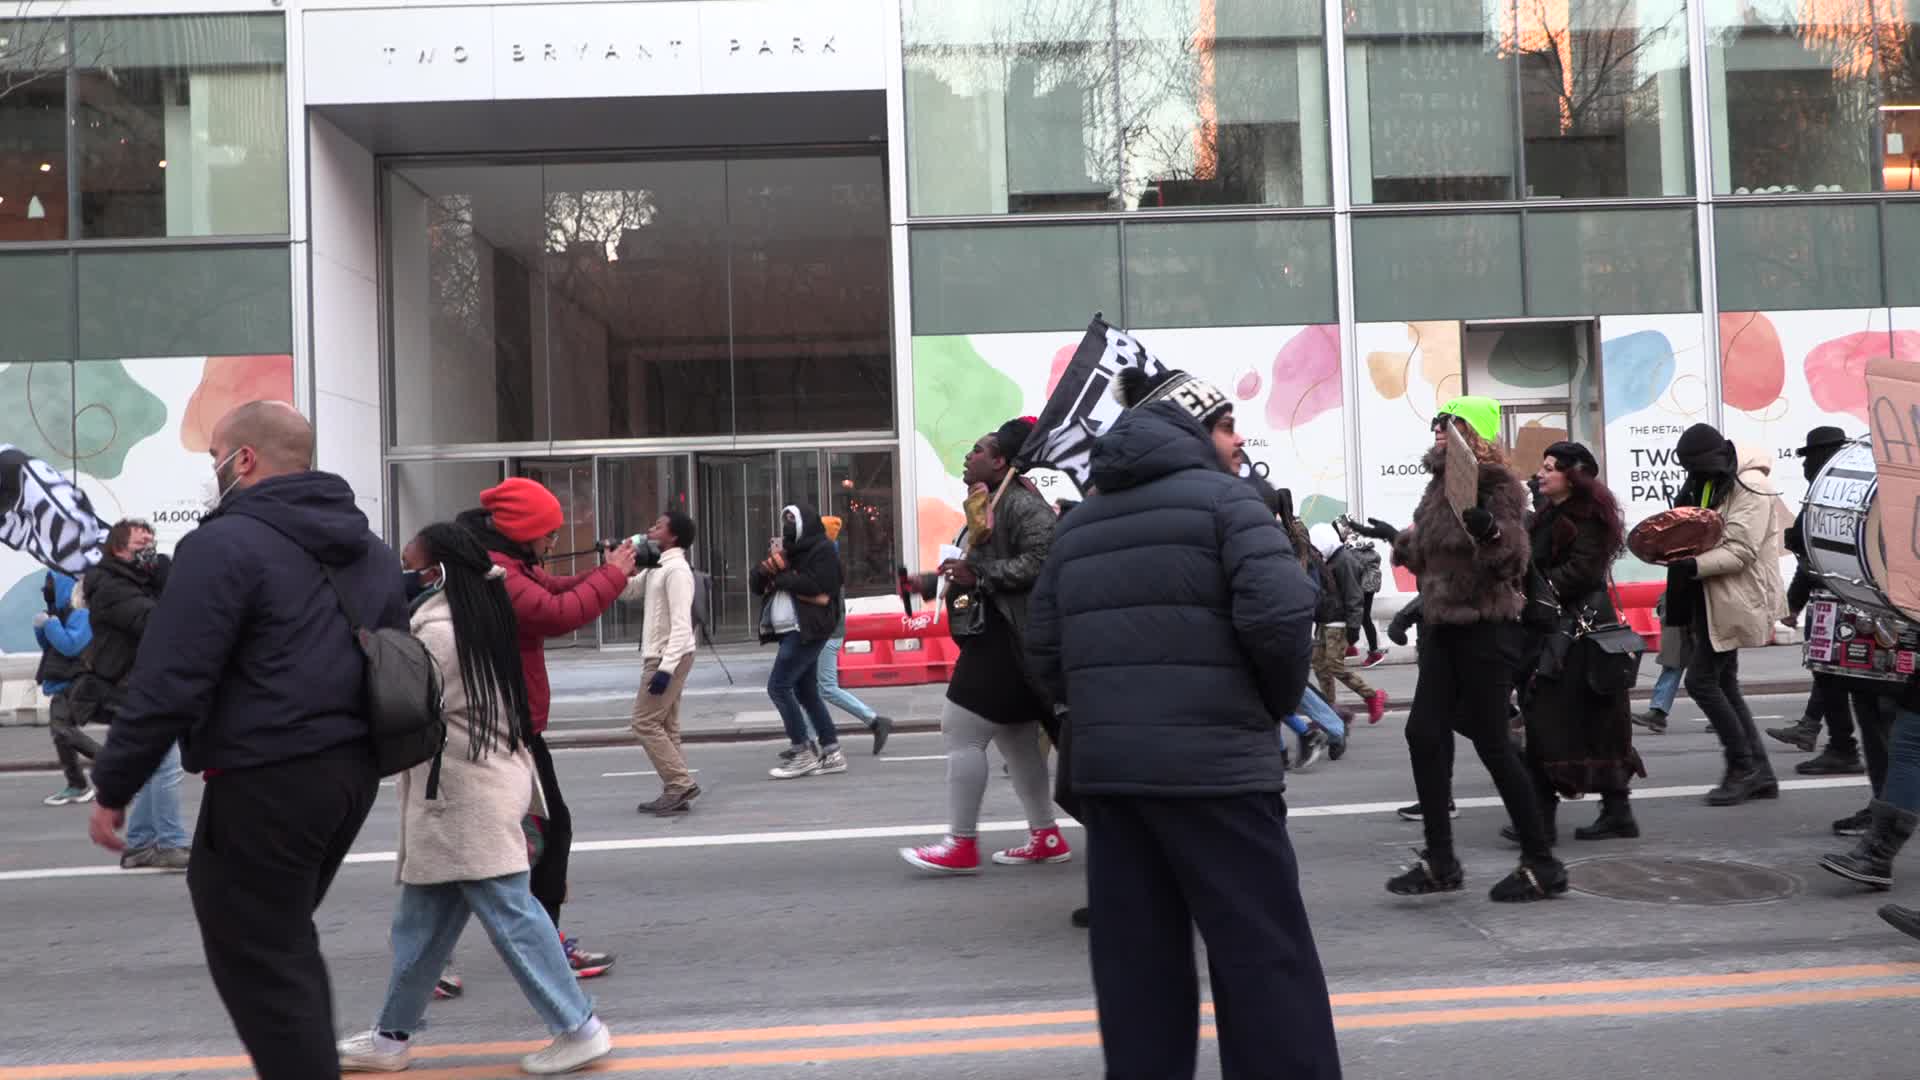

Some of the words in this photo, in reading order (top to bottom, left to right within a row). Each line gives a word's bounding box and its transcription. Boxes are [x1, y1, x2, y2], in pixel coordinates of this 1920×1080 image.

[382, 45, 470, 64] TWO
[511, 41, 683, 62] BRYANT
[727, 35, 836, 55] PARK
[1629, 426, 1650, 435] THE
[1040, 475, 1059, 488] SF
[1630, 470, 1688, 482] BRYANT
[1822, 479, 1868, 504] LIVES
[1809, 511, 1857, 538] MATTER
